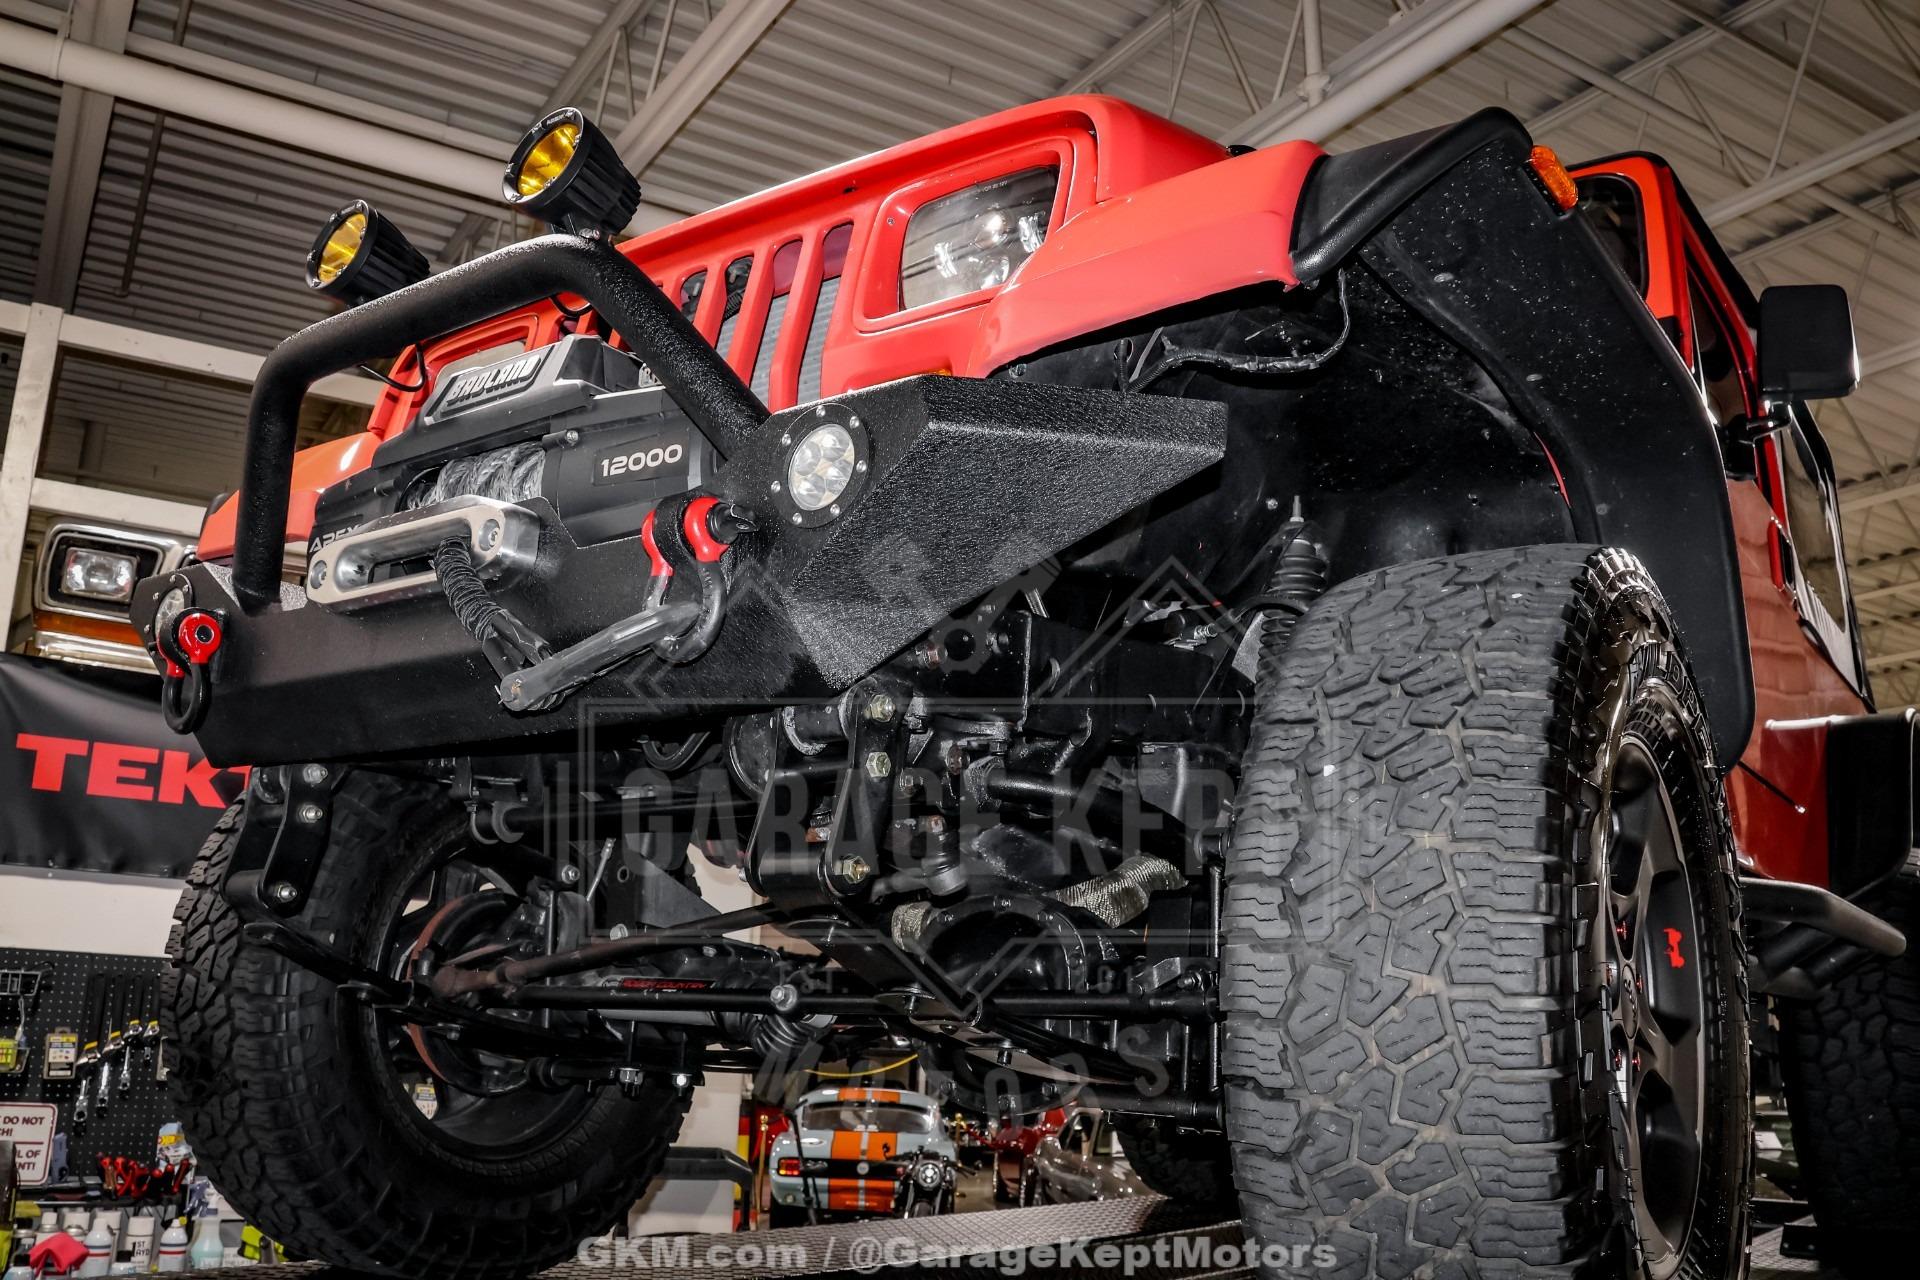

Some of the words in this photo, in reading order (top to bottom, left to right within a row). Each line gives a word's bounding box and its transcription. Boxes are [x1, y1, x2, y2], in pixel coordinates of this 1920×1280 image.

[451, 354, 541, 398] BADLAND
[601, 444, 683, 478] 12000
[3, 1116, 20, 1125] DO
[22, 1116, 45, 1125] NOT
[26, 1150, 41, 1158] OF
